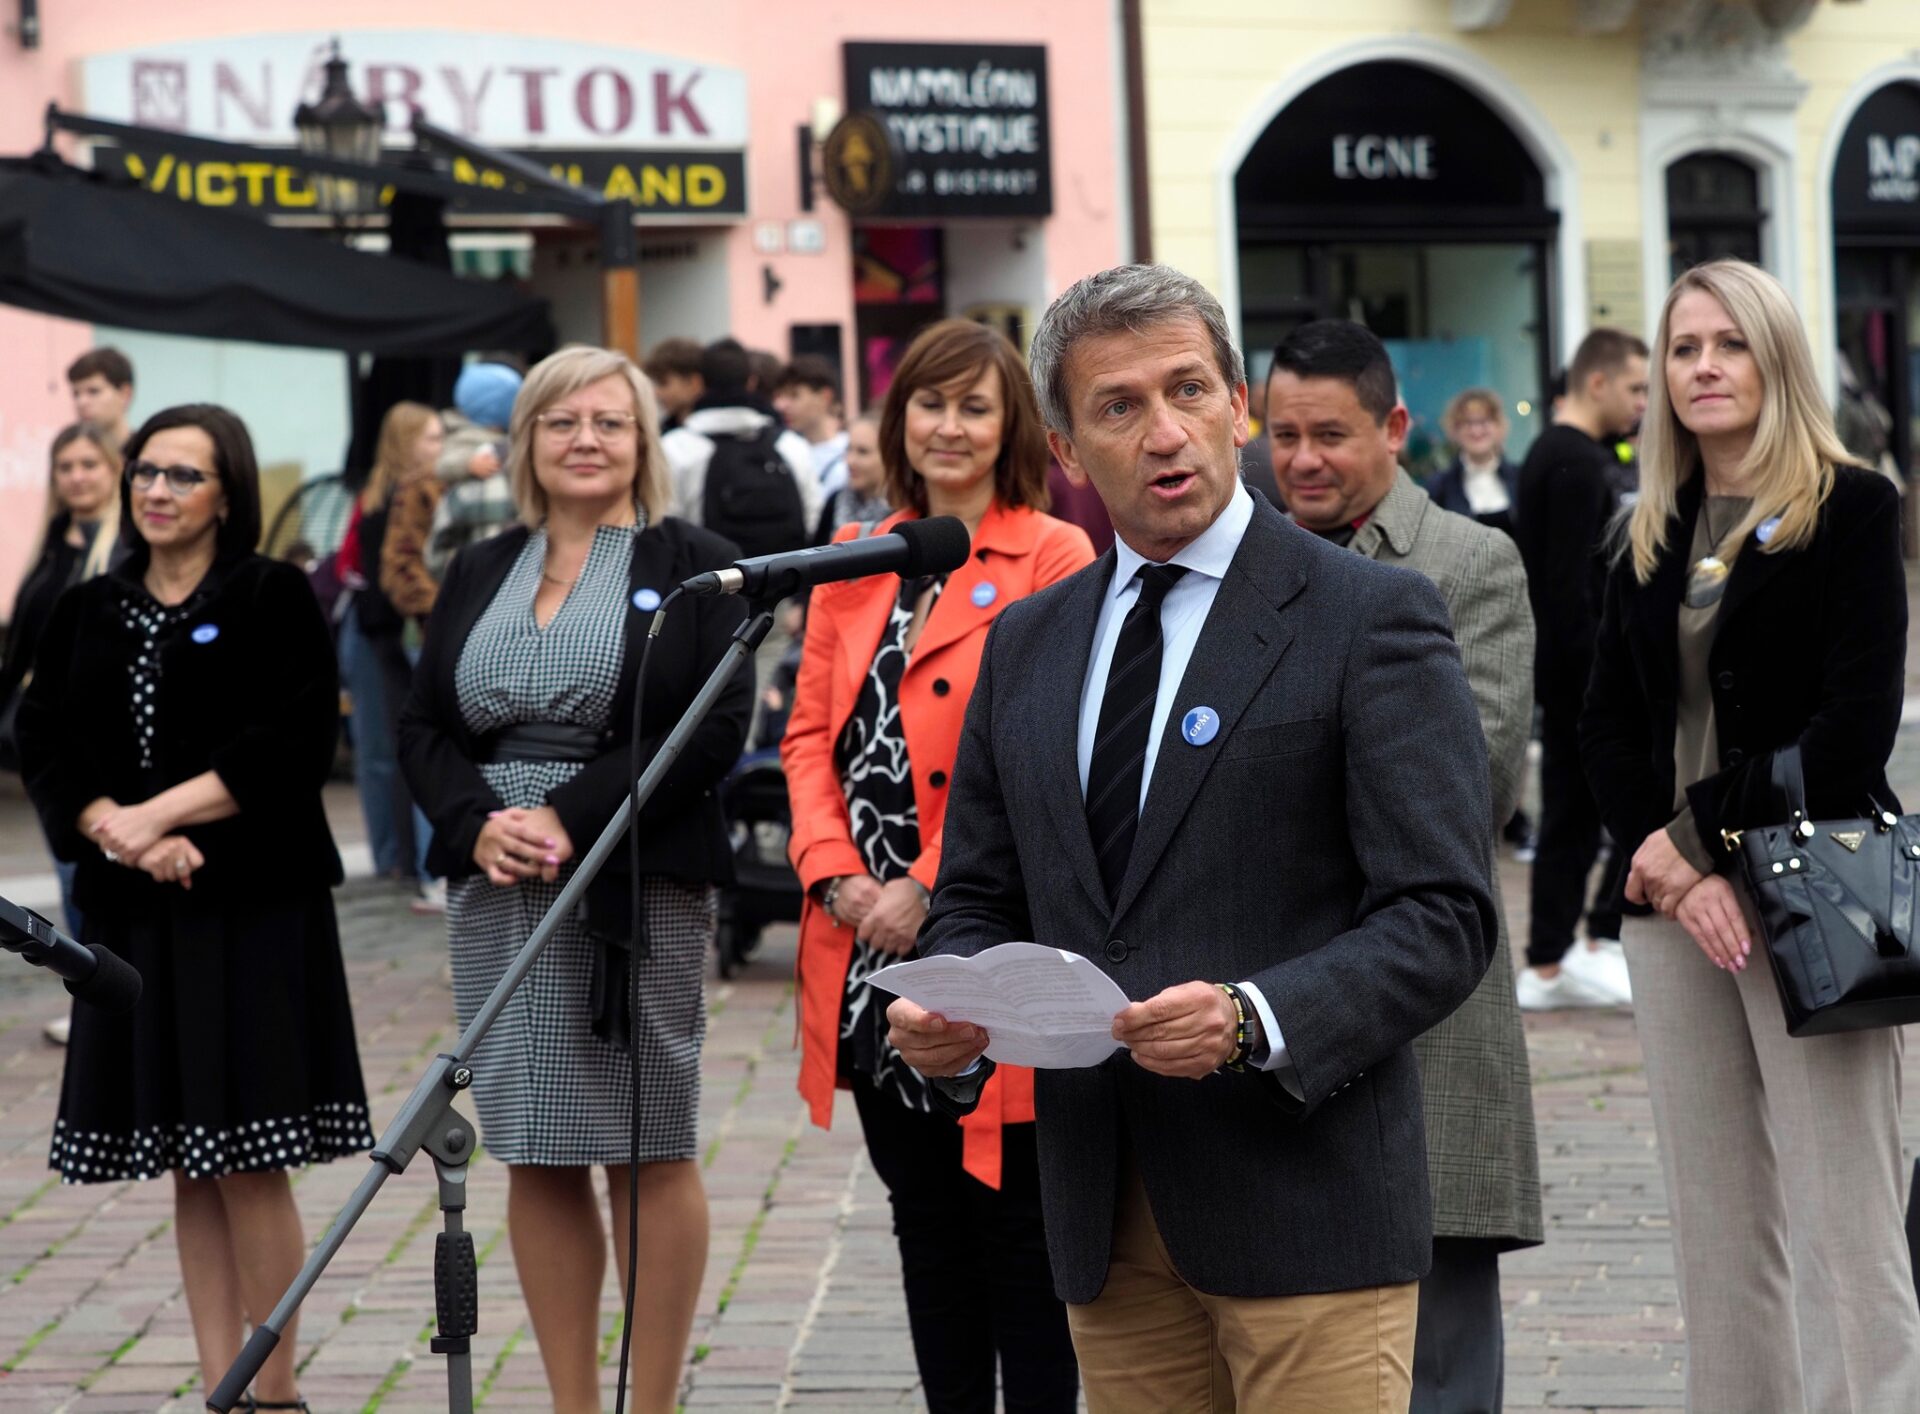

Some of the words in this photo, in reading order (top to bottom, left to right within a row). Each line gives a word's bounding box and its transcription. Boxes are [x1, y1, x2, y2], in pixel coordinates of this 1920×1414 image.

[213, 55, 711, 137] NBYTOK
[885, 113, 1039, 158] YSTIQUE
[1332, 133, 1437, 180] EGNE
